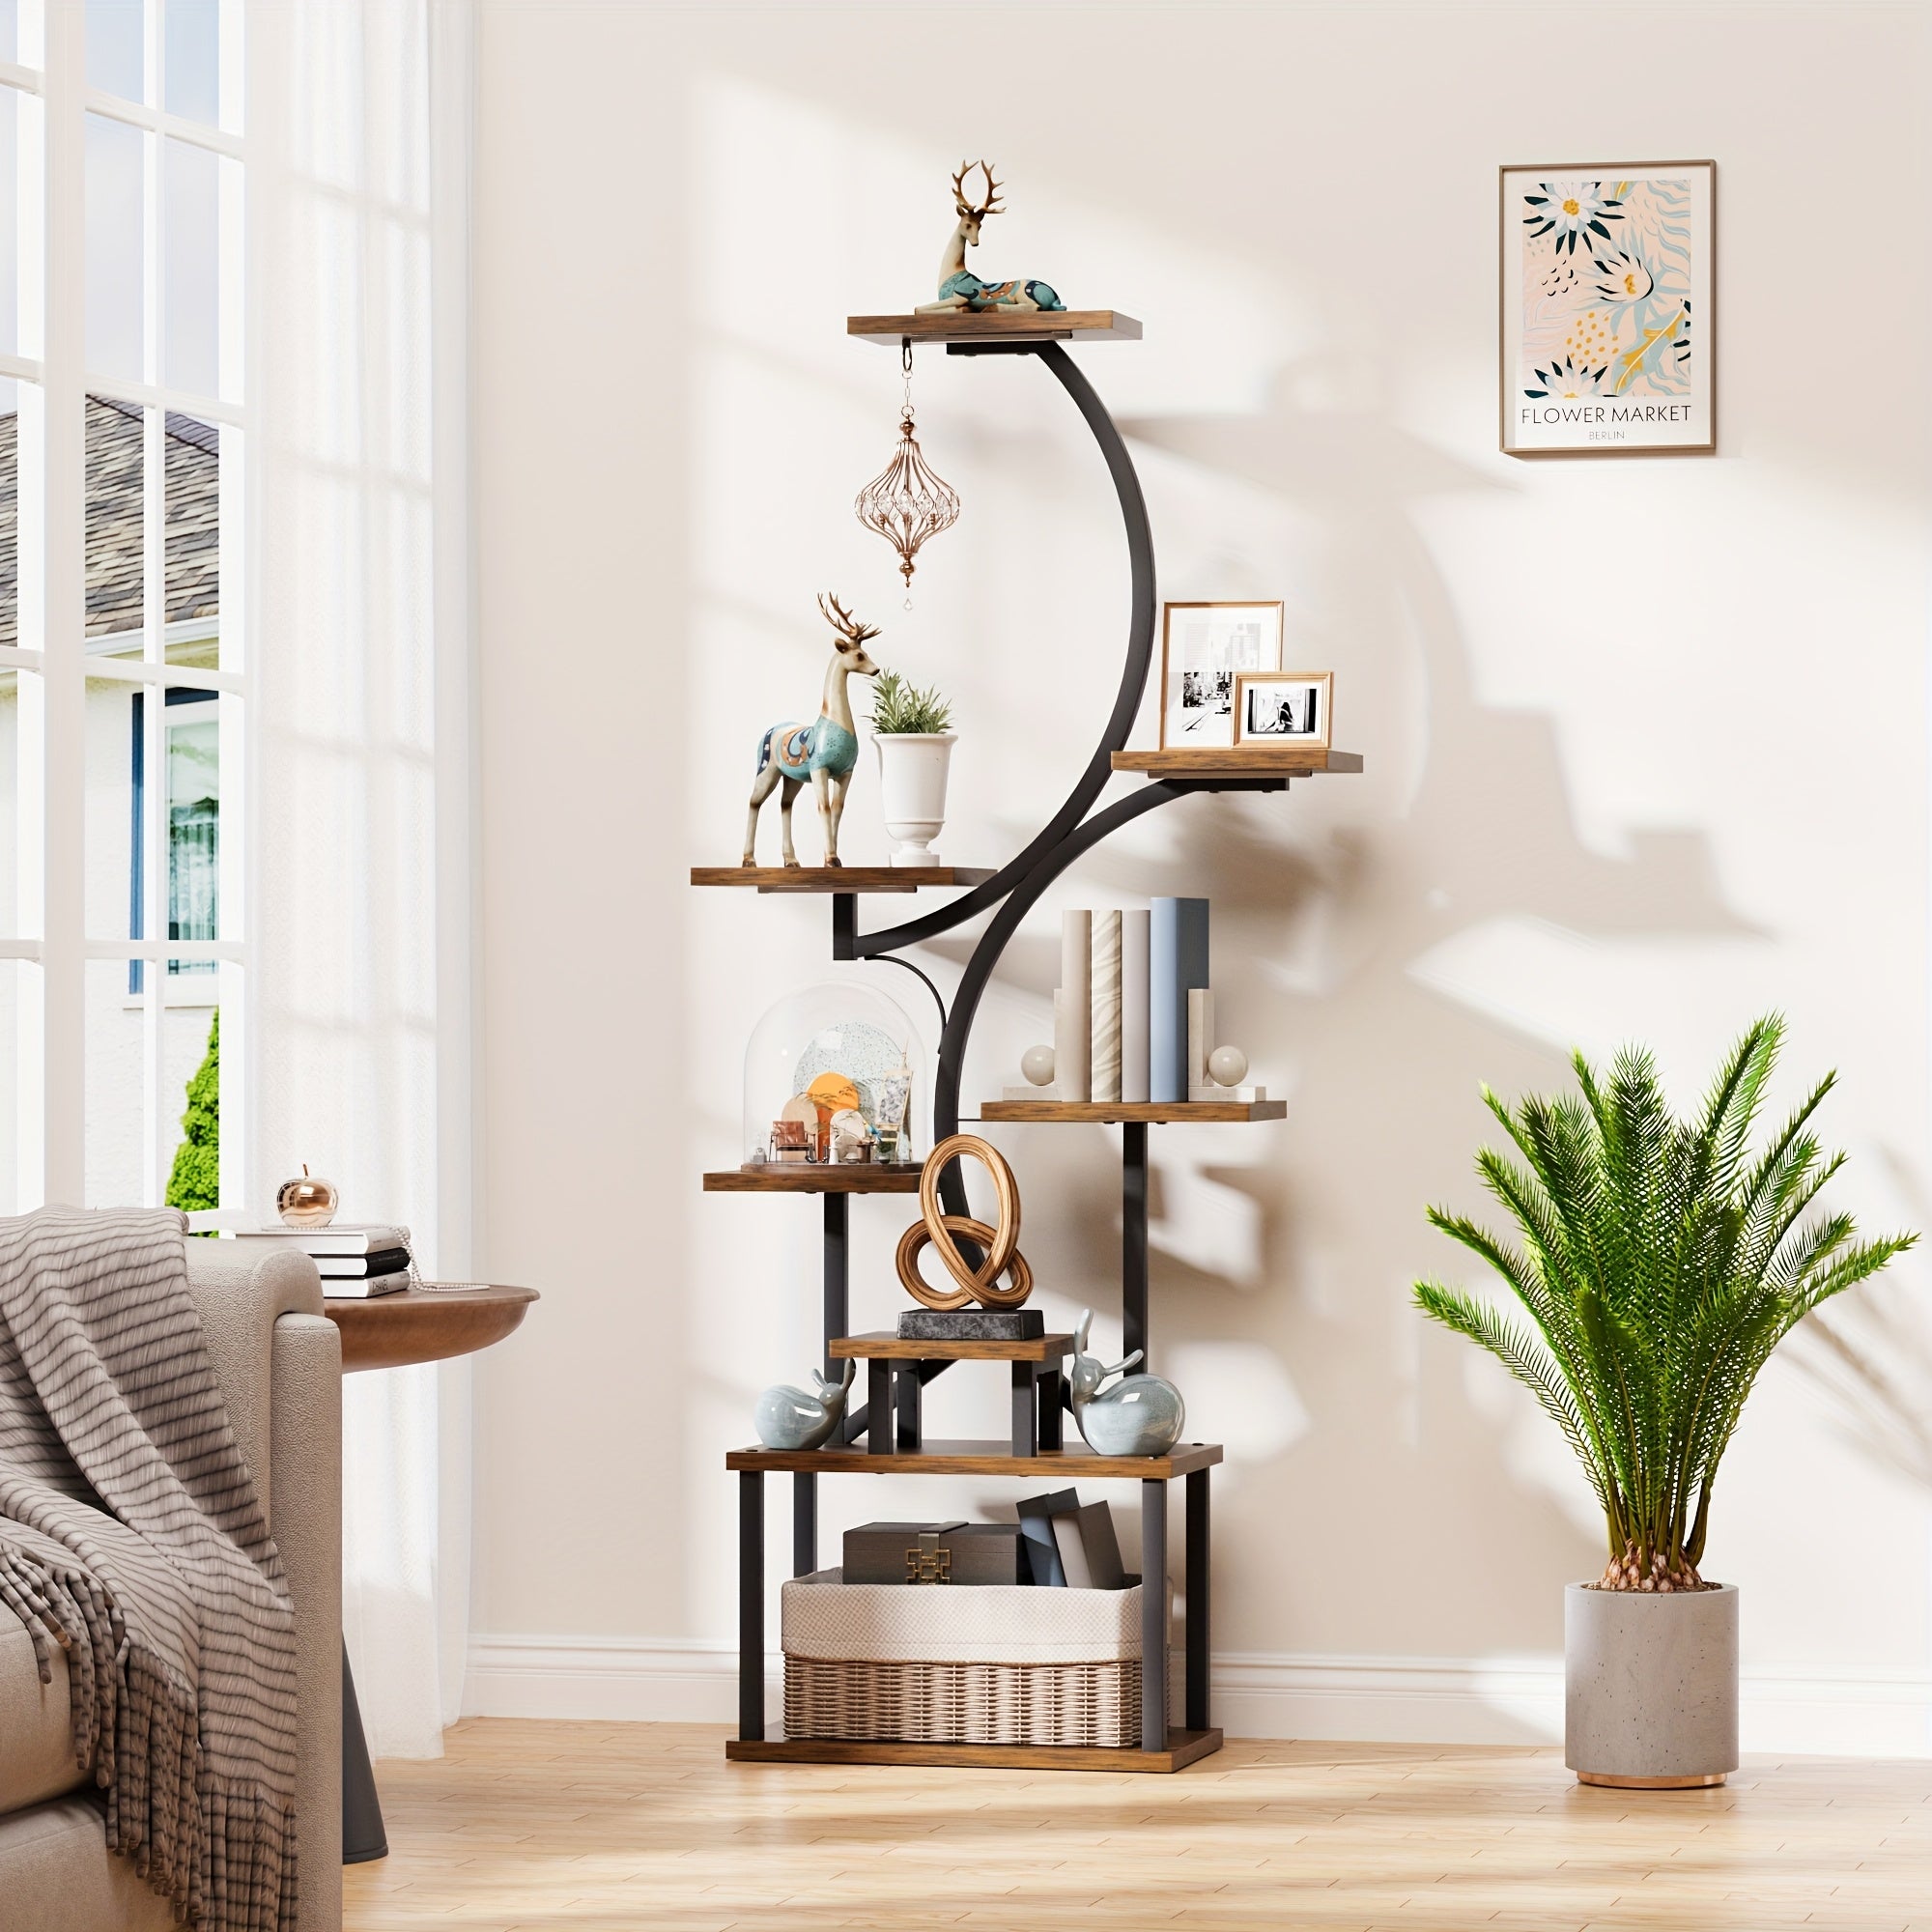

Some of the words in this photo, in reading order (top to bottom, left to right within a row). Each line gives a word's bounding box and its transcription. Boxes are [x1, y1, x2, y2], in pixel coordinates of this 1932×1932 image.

[1522, 407, 1605, 424] FLOWER
[1611, 405, 1691, 422] MARKET
[1588, 431, 1625, 440] BERLIN
